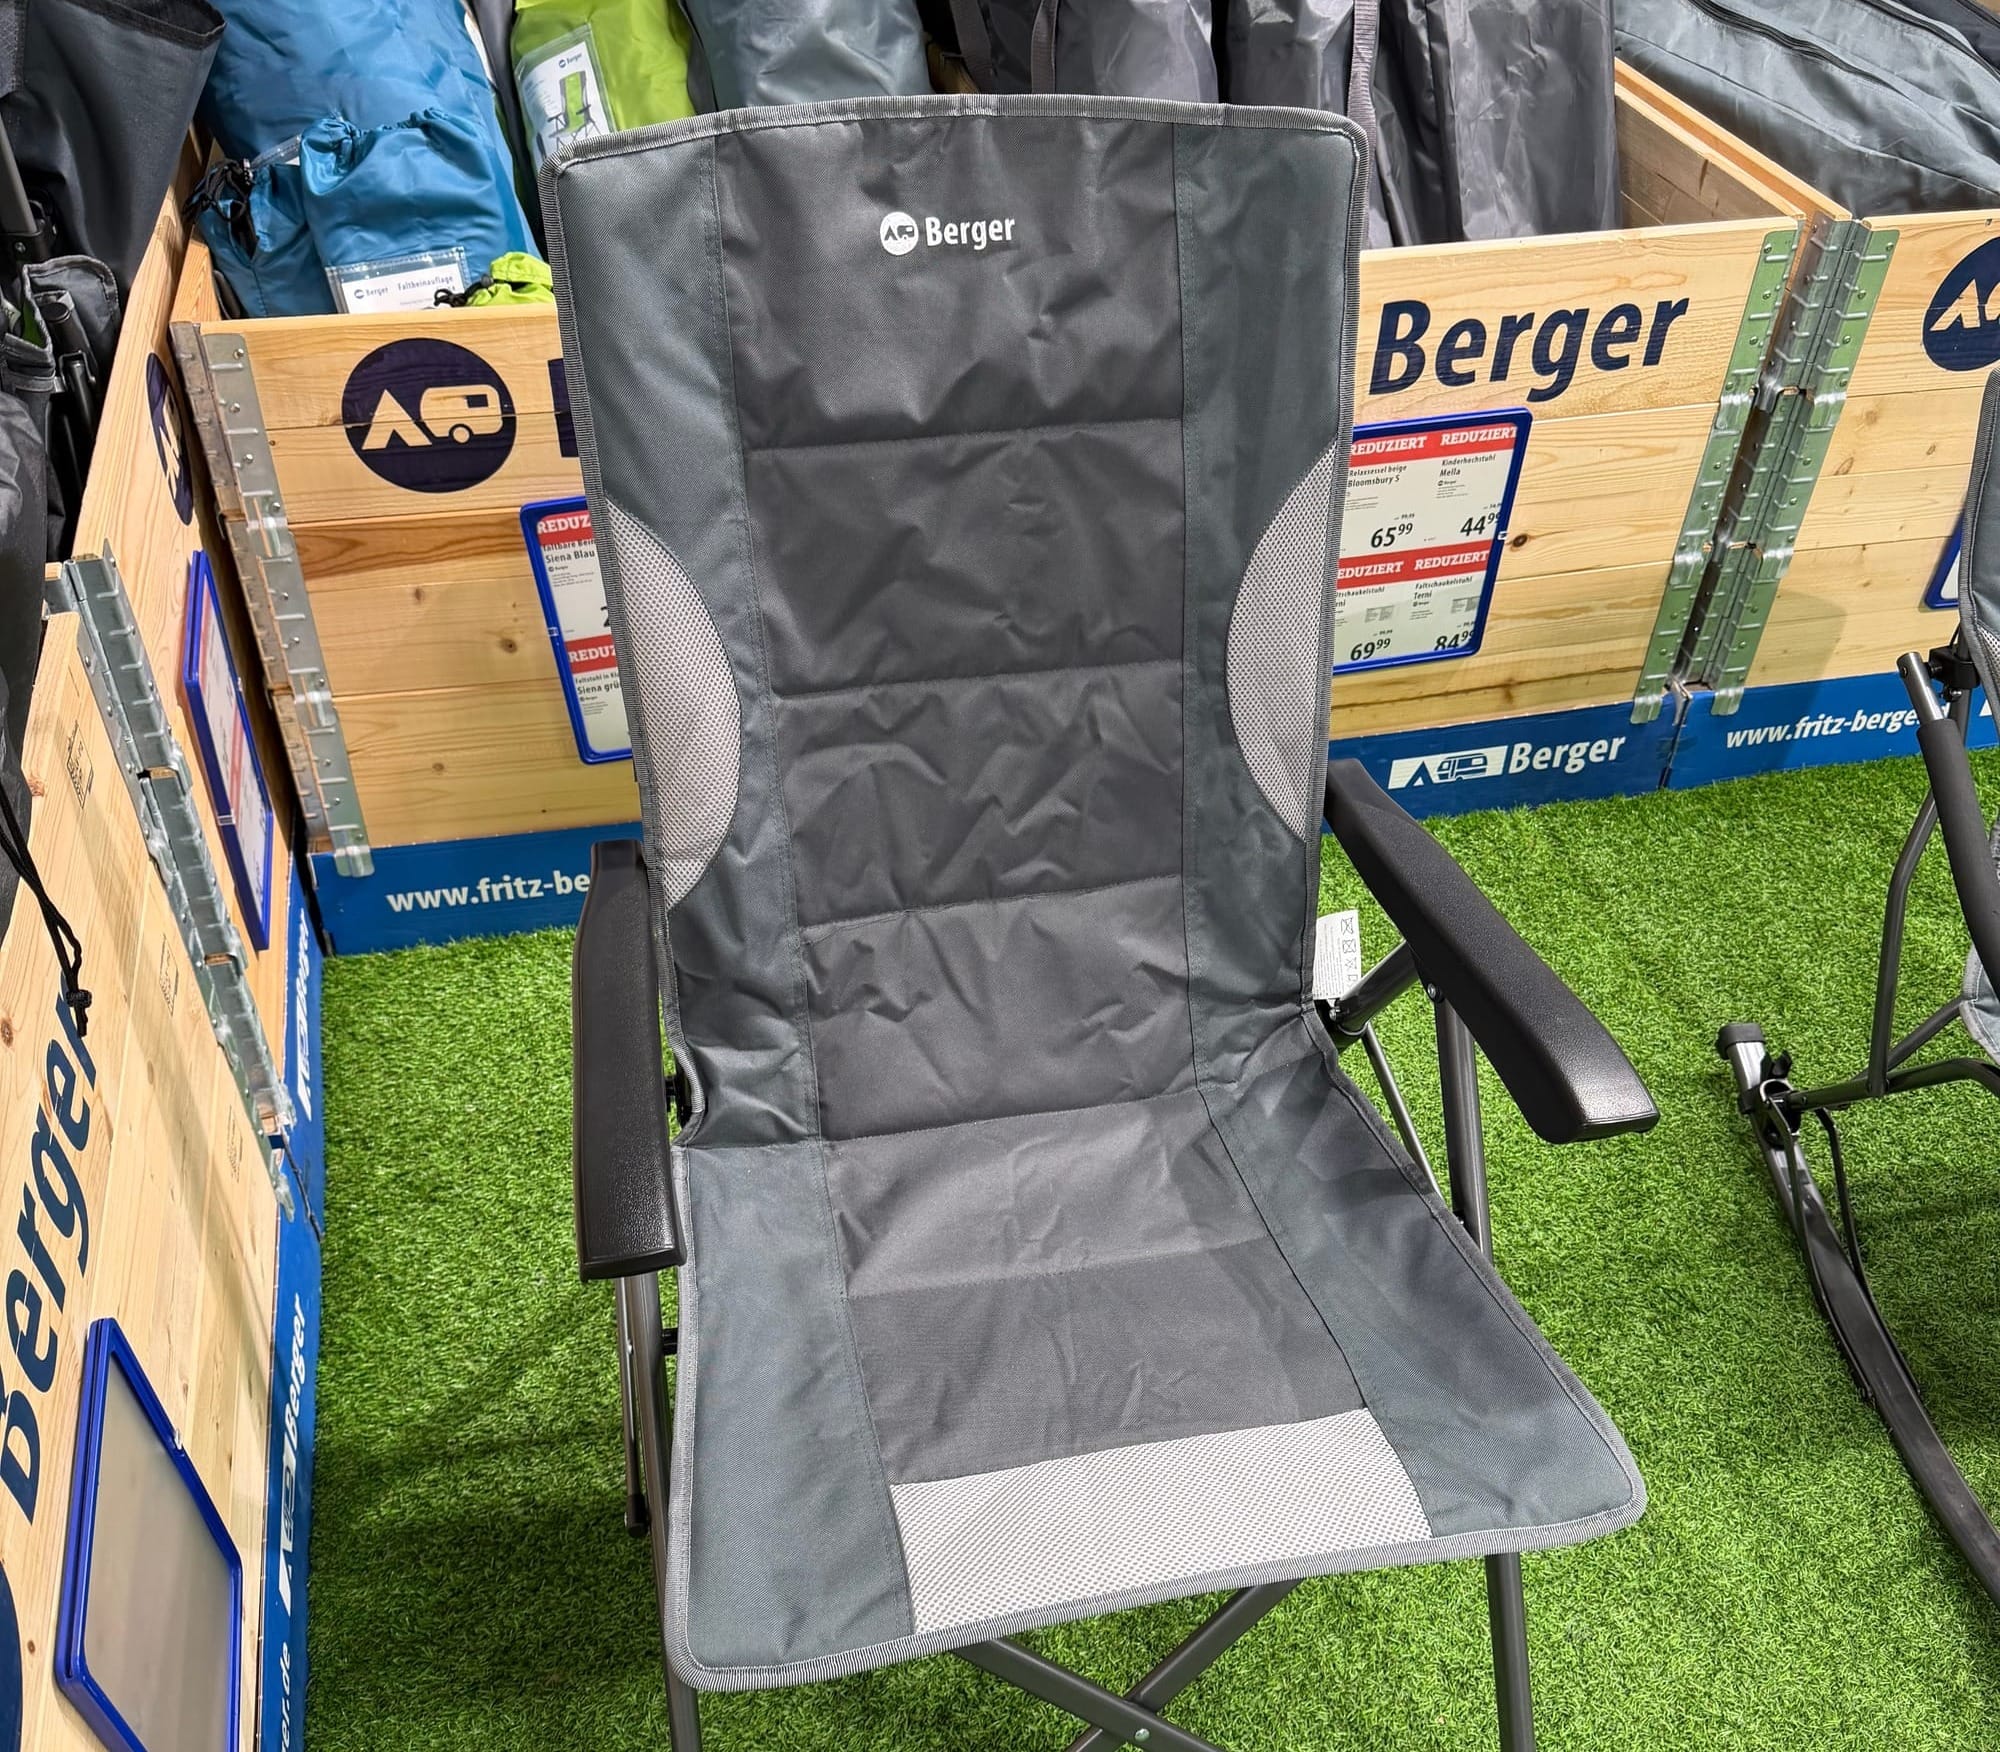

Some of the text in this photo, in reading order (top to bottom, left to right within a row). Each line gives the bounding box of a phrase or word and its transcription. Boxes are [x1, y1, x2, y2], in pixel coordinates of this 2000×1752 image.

[925, 216, 1016, 251] Berger
[1369, 297, 1690, 403] Berger
[1440, 426, 1518, 446] REDUZIERT
[1439, 468, 1461, 477] Mella
[545, 549, 595, 564] Siena Blau
[1414, 550, 1490, 571] REDUZIERT
[577, 685, 603, 695] Siena
[1508, 736, 1626, 775] Berger
[285, 1292, 306, 1451] Berger
